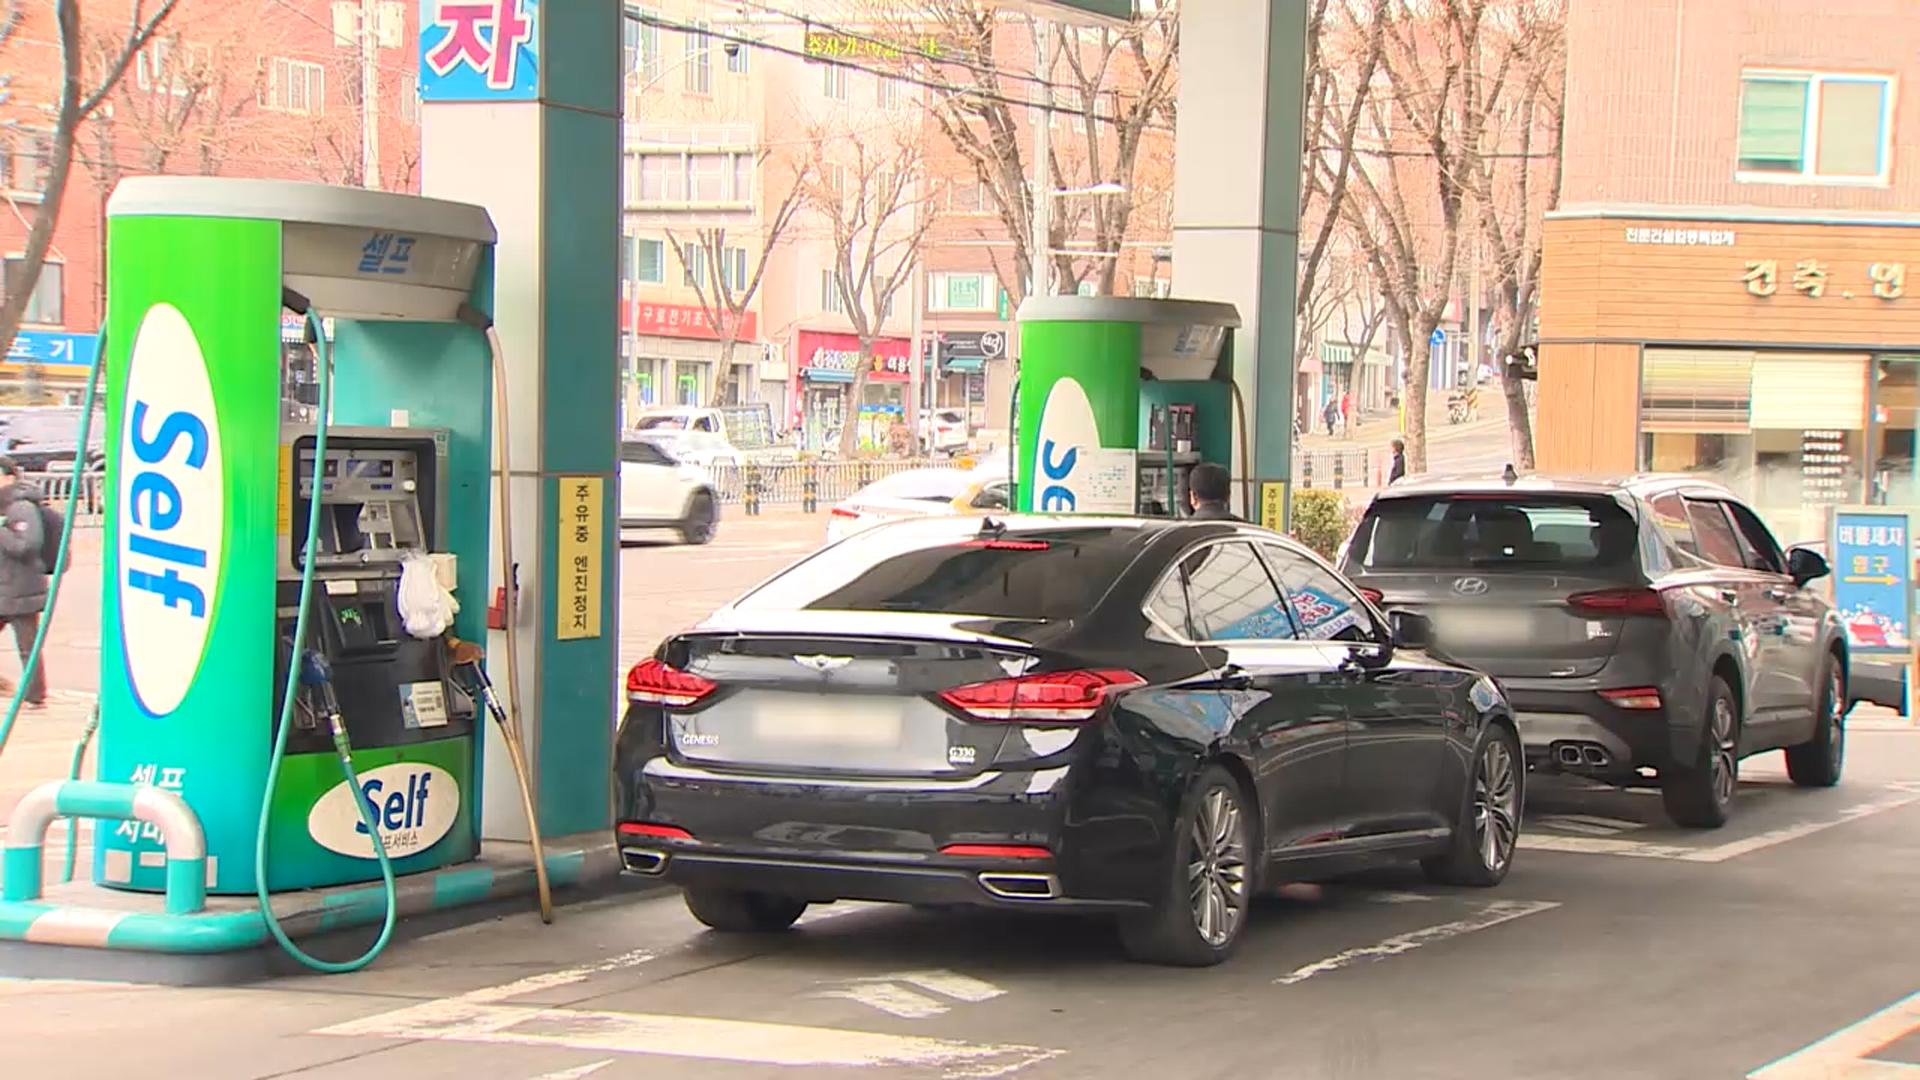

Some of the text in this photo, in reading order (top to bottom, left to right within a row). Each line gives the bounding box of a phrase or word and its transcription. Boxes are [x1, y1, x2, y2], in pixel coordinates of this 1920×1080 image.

[357, 232, 416, 274] 셀프
[1041, 439, 1077, 512] Se
[128, 399, 209, 619] Self
[573, 485, 589, 631] 주유중 엔진정지
[682, 733, 720, 746] GENESIS
[355, 772, 432, 835] Self
[374, 830, 418, 852] 프서비스
